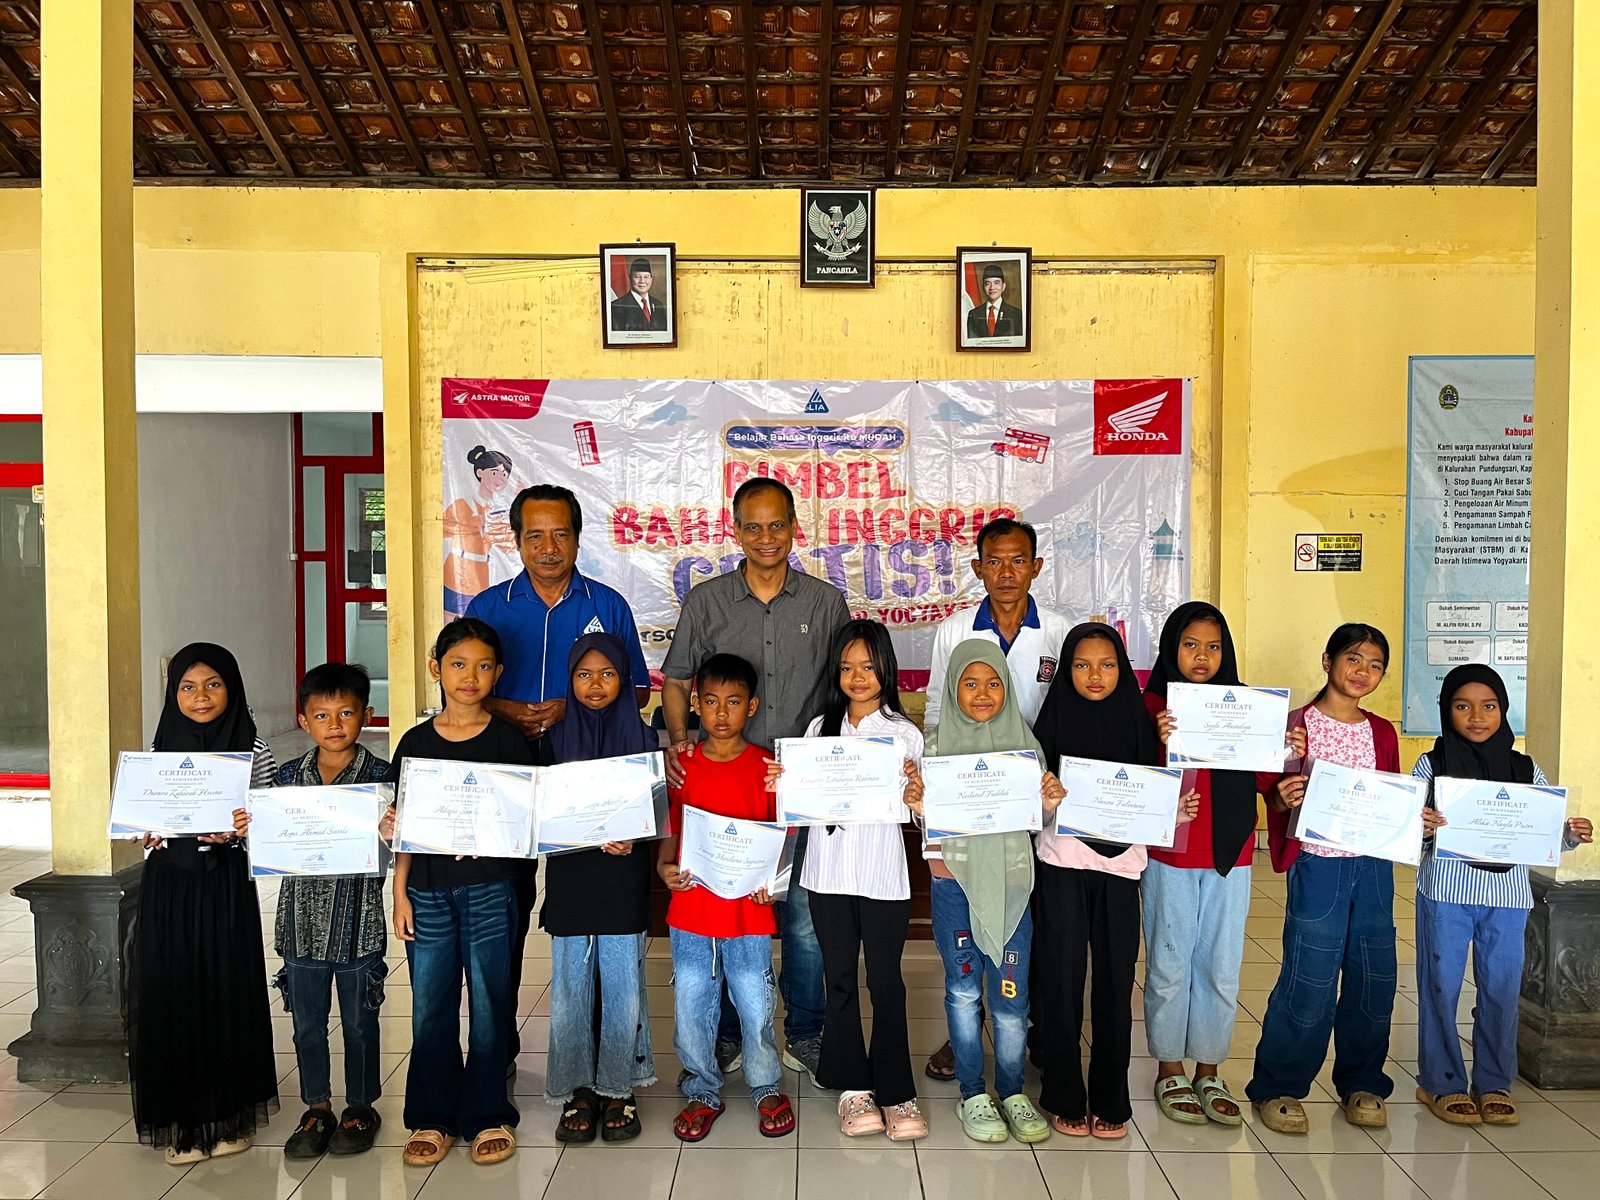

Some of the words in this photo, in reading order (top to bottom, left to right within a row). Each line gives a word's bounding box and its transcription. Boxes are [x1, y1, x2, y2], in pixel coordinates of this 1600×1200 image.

[734, 433, 768, 443] Belajar
[770, 433, 804, 441] Bahasa
[808, 433, 842, 442] Inggris
[1106, 432, 1169, 440] HONDA
[1475, 443, 1510, 452] masyarakat
[1438, 454, 1476, 462] menyepakati
[1479, 464, 1519, 474] Pundungsari,
[1454, 478, 1470, 487] Stop
[1471, 478, 1492, 487] Buang
[1470, 489, 1494, 498] Tangan
[1454, 500, 1492, 508] Pengeloaan
[1454, 511, 1496, 520] Pengamanan
[1499, 511, 1526, 519] Sampah
[1454, 522, 1496, 530] Pengamanan
[1434, 546, 1475, 555] Masyarakat
[1480, 546, 1504, 554] (STBM)
[958, 770, 1006, 779] CERTIFICATE
[1097, 779, 1145, 789] CERTIFICATE
[1477, 800, 1528, 809] CERTIFICATE
[709, 831, 754, 844] CERTIFICATE
[1009, 954, 1014, 962] 8
[1002, 980, 1017, 998] B
